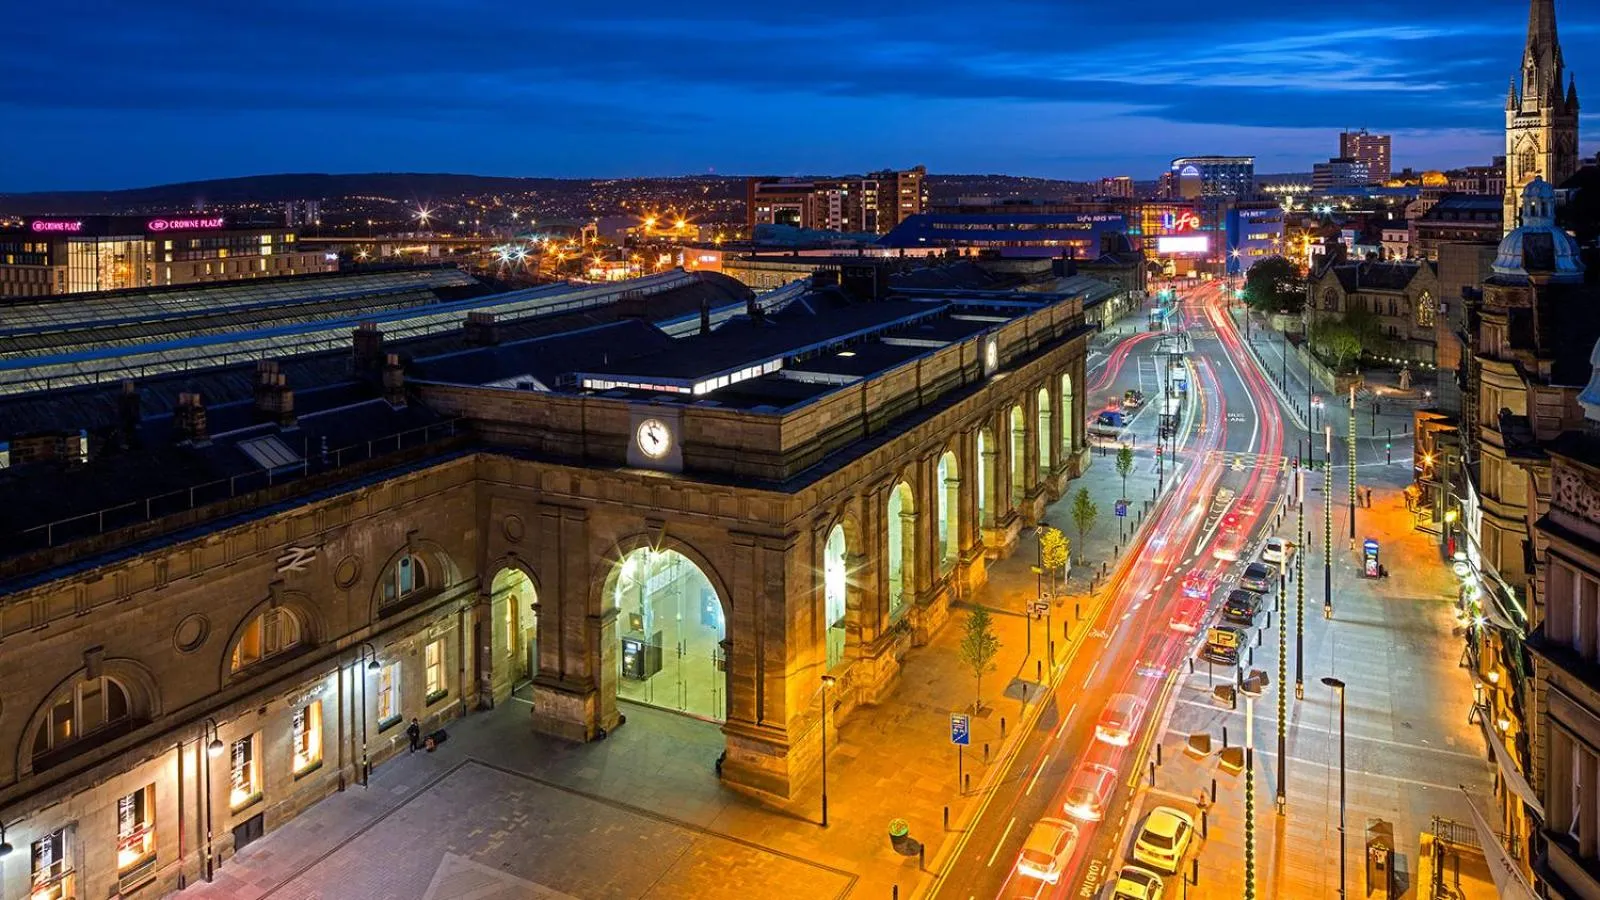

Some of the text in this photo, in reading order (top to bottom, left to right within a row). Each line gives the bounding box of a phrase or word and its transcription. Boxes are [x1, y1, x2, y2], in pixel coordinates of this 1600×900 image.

[169, 219, 222, 229] CROWNE PLAZA
[1164, 212, 1200, 231] Life
[1079, 859, 1103, 898] LOADING
